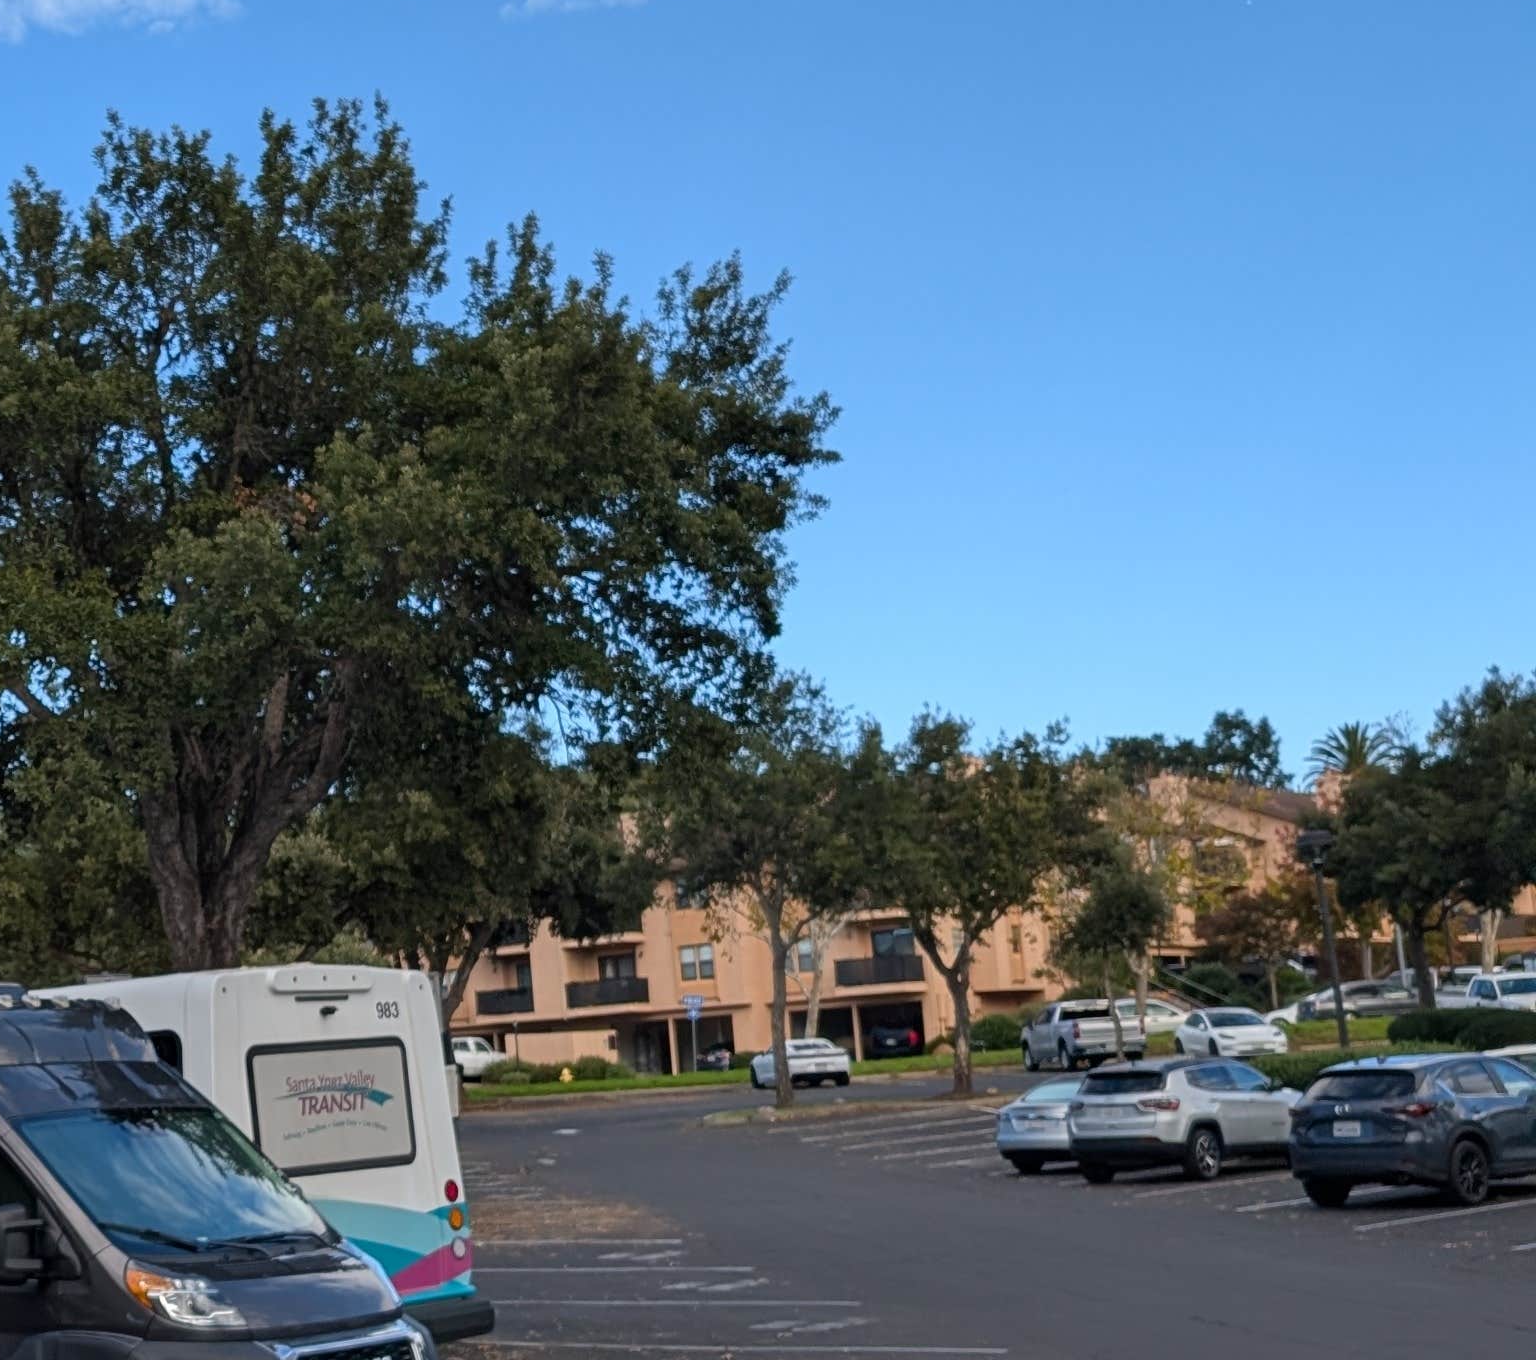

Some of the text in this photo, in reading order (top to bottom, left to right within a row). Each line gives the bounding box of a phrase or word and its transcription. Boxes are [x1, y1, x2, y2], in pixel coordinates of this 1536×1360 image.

[375, 1001, 399, 1019] 983
[285, 1076, 316, 1093] Santa
[344, 1070, 376, 1089] Valley
[297, 1092, 364, 1116] TRANSIT
